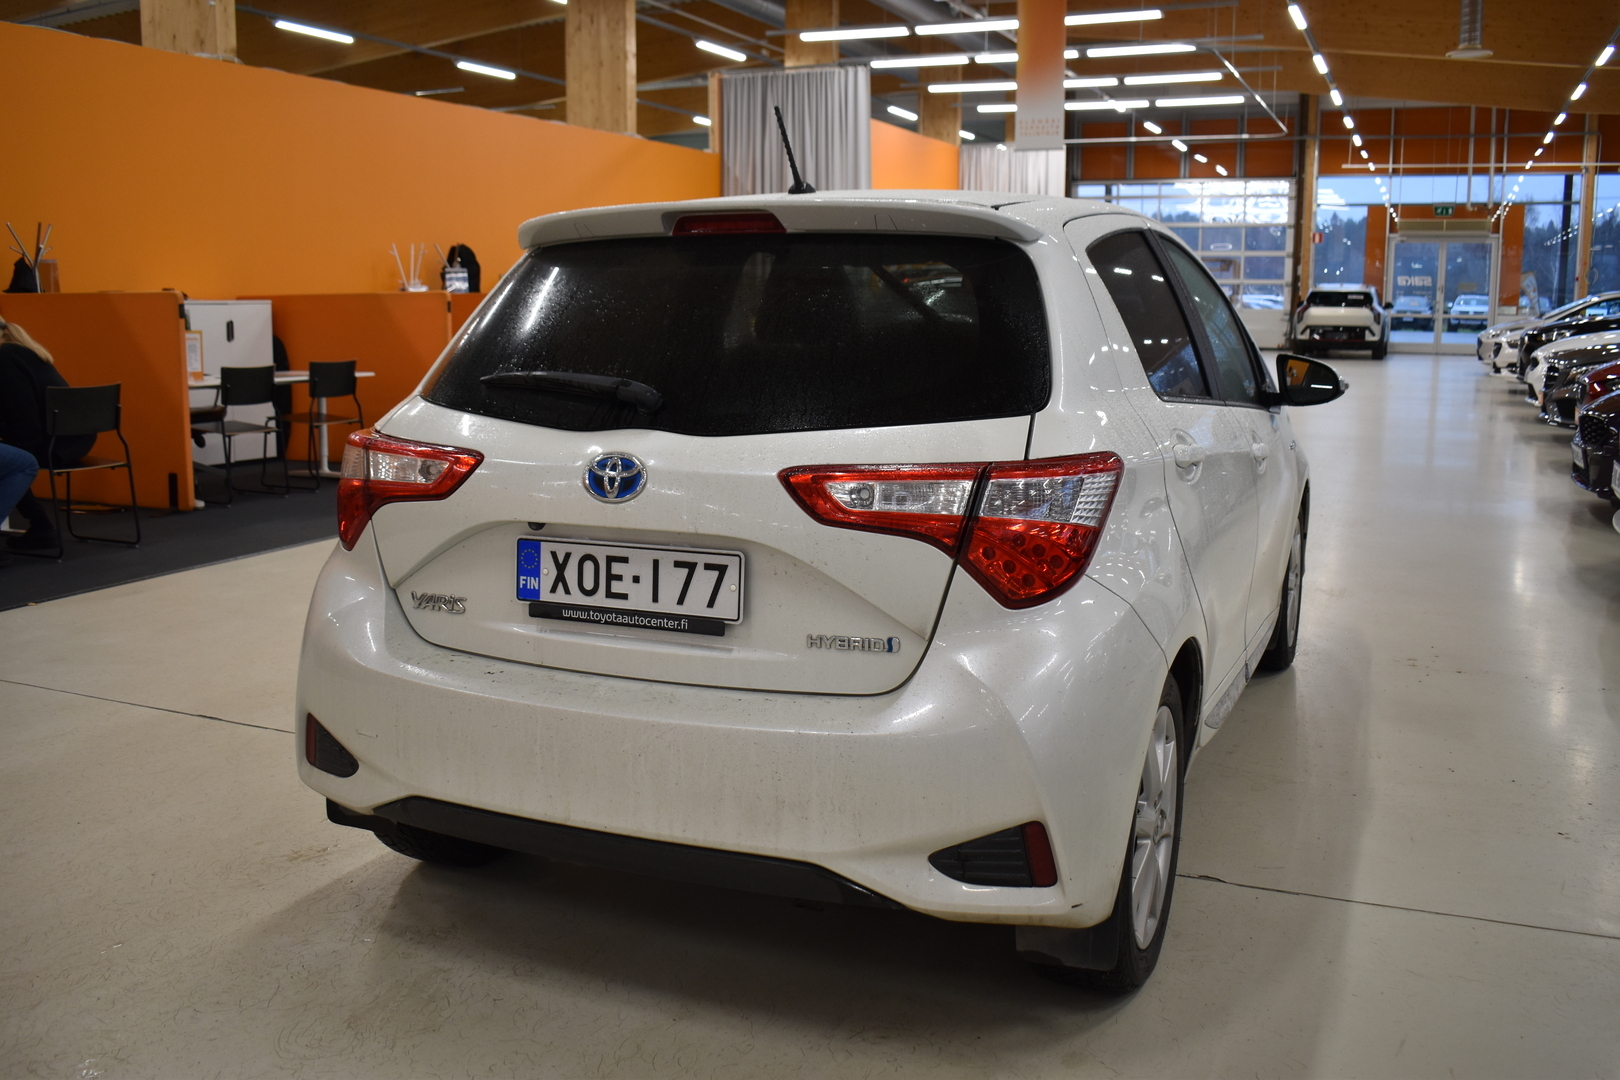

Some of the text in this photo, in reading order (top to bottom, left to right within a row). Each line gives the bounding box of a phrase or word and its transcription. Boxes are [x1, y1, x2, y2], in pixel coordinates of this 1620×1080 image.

[519, 575, 539, 590] FIN
[562, 607, 688, 630] www.toyotaautocenter.fi
[807, 634, 884, 652] HYBRID
